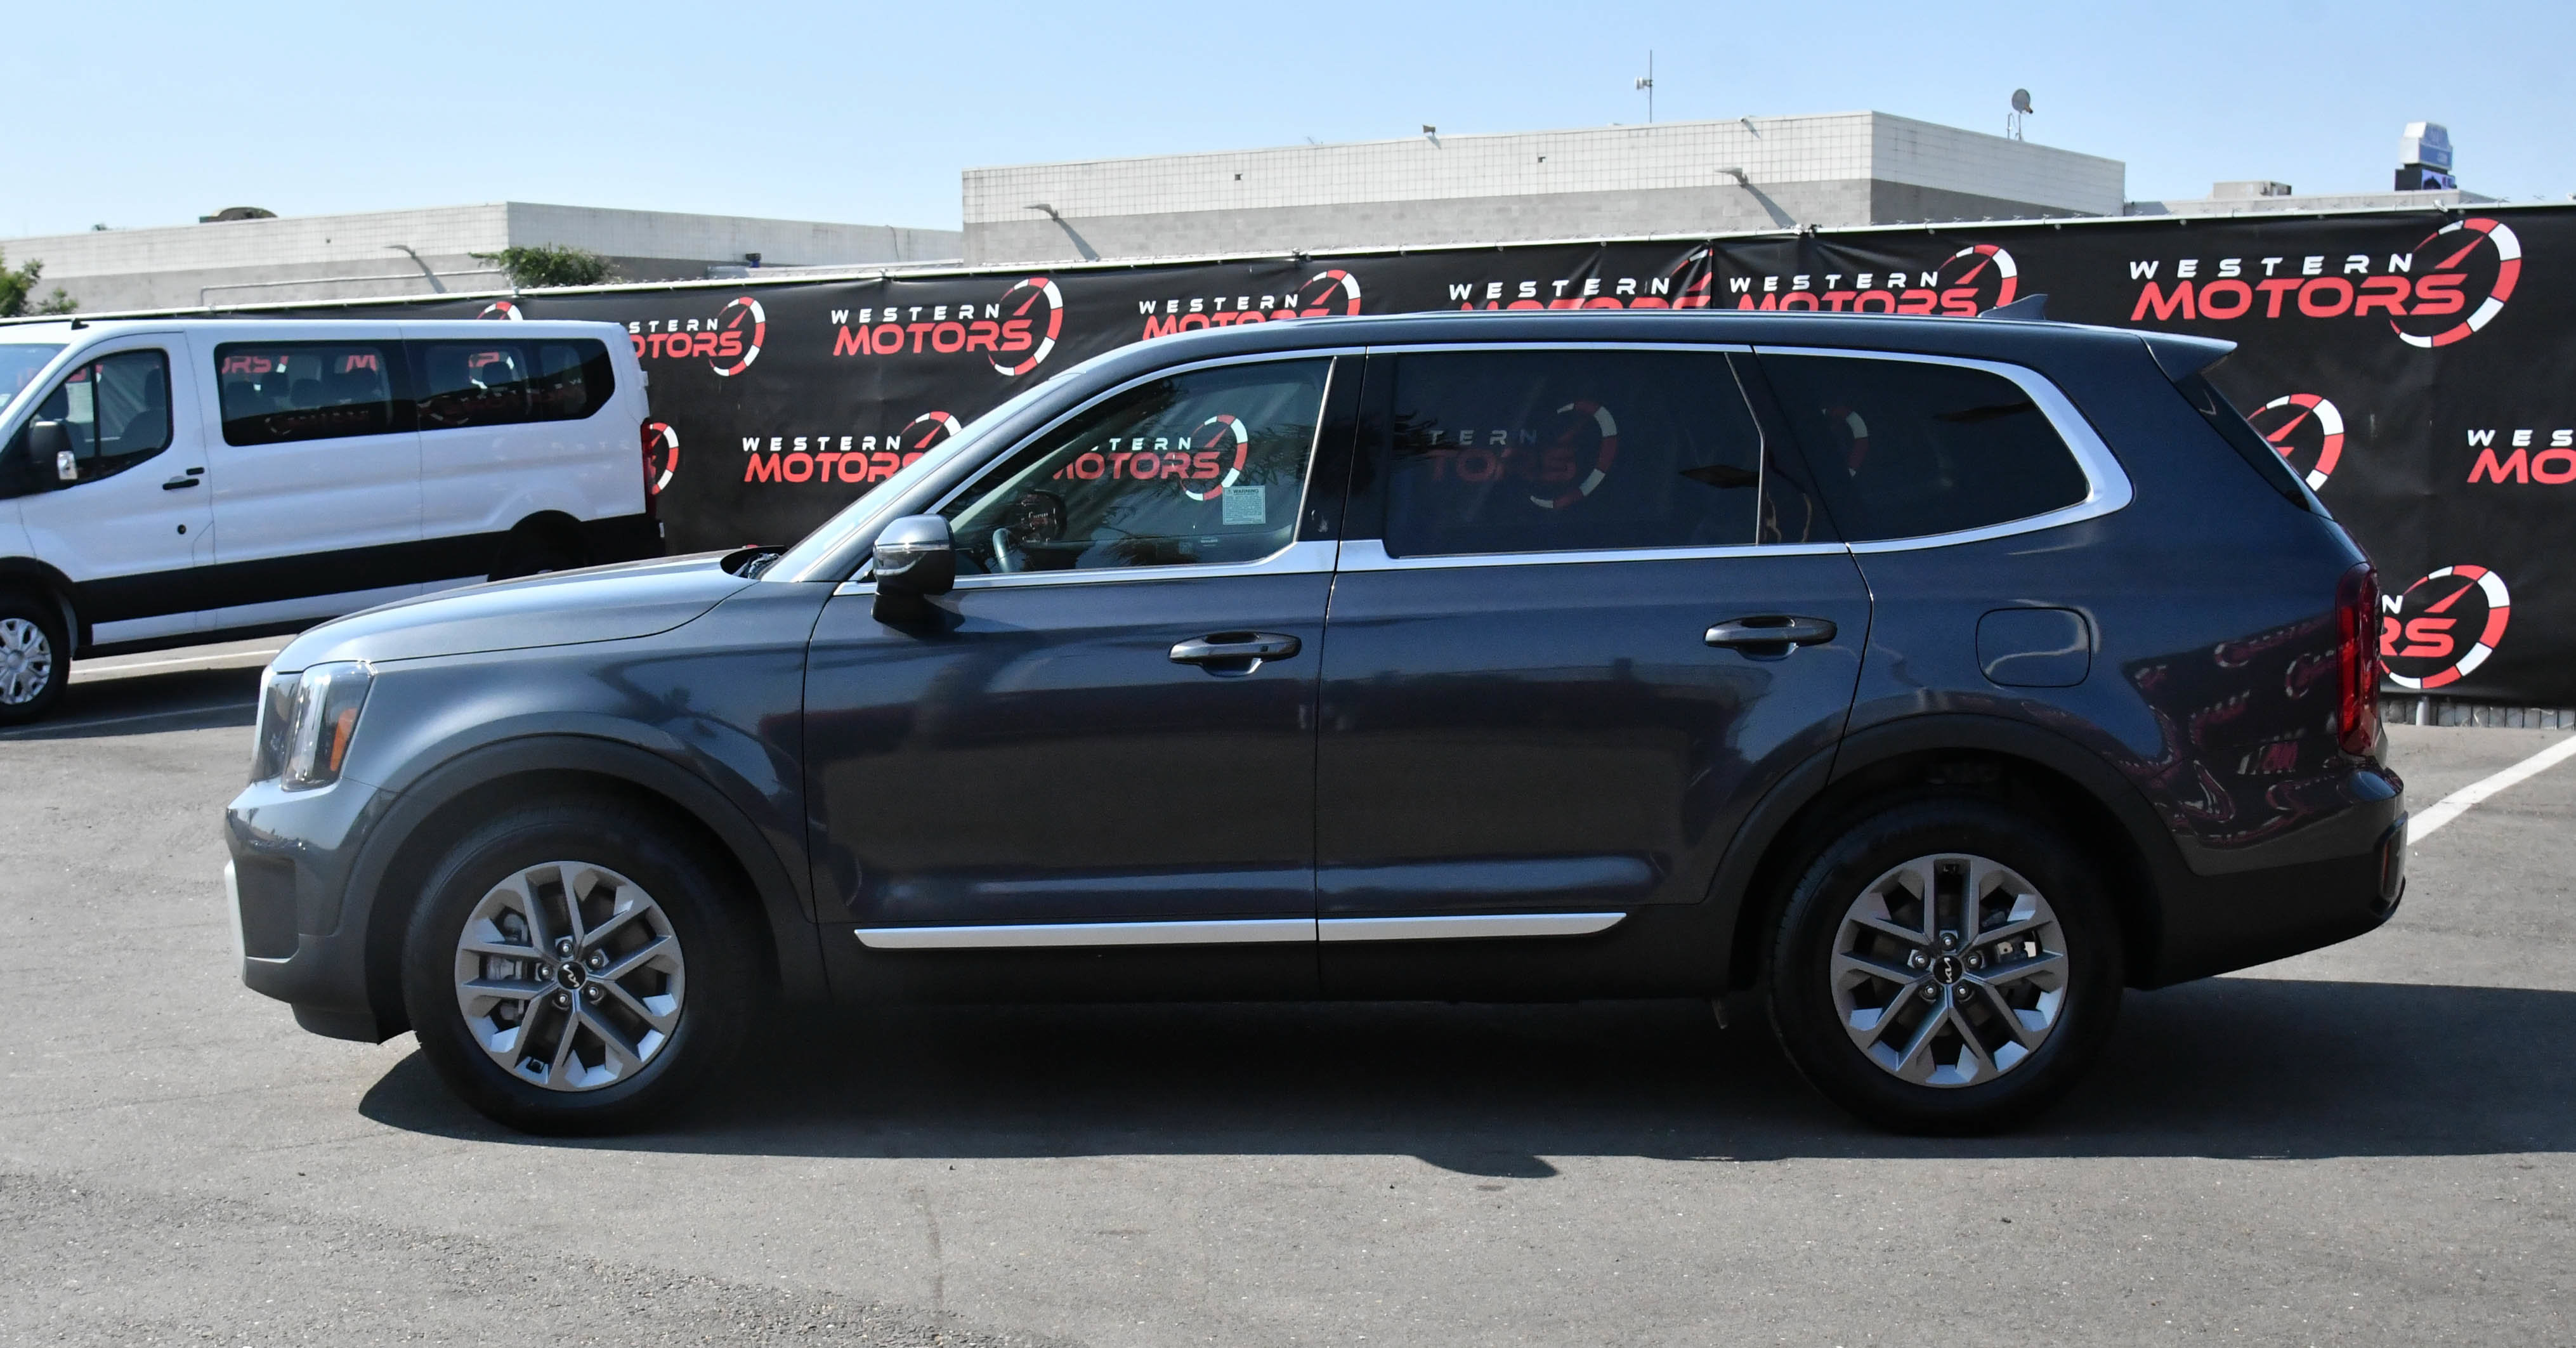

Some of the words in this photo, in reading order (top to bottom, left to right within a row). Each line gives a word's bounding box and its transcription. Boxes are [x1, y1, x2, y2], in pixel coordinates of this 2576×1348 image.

[2129, 253, 2413, 280] WESTERN
[1449, 277, 1670, 300] WESTERN
[1730, 272, 1939, 292] WESTERN
[1139, 294, 1298, 314] WESTERN
[2130, 273, 2468, 321] MOTORS
[831, 303, 1000, 324] WESTERN
[1142, 308, 1330, 341] MOT
[833, 319, 1033, 356] MOTORS
[742, 436, 901, 451] WESTERN
[1092, 436, 1191, 451] TERN
